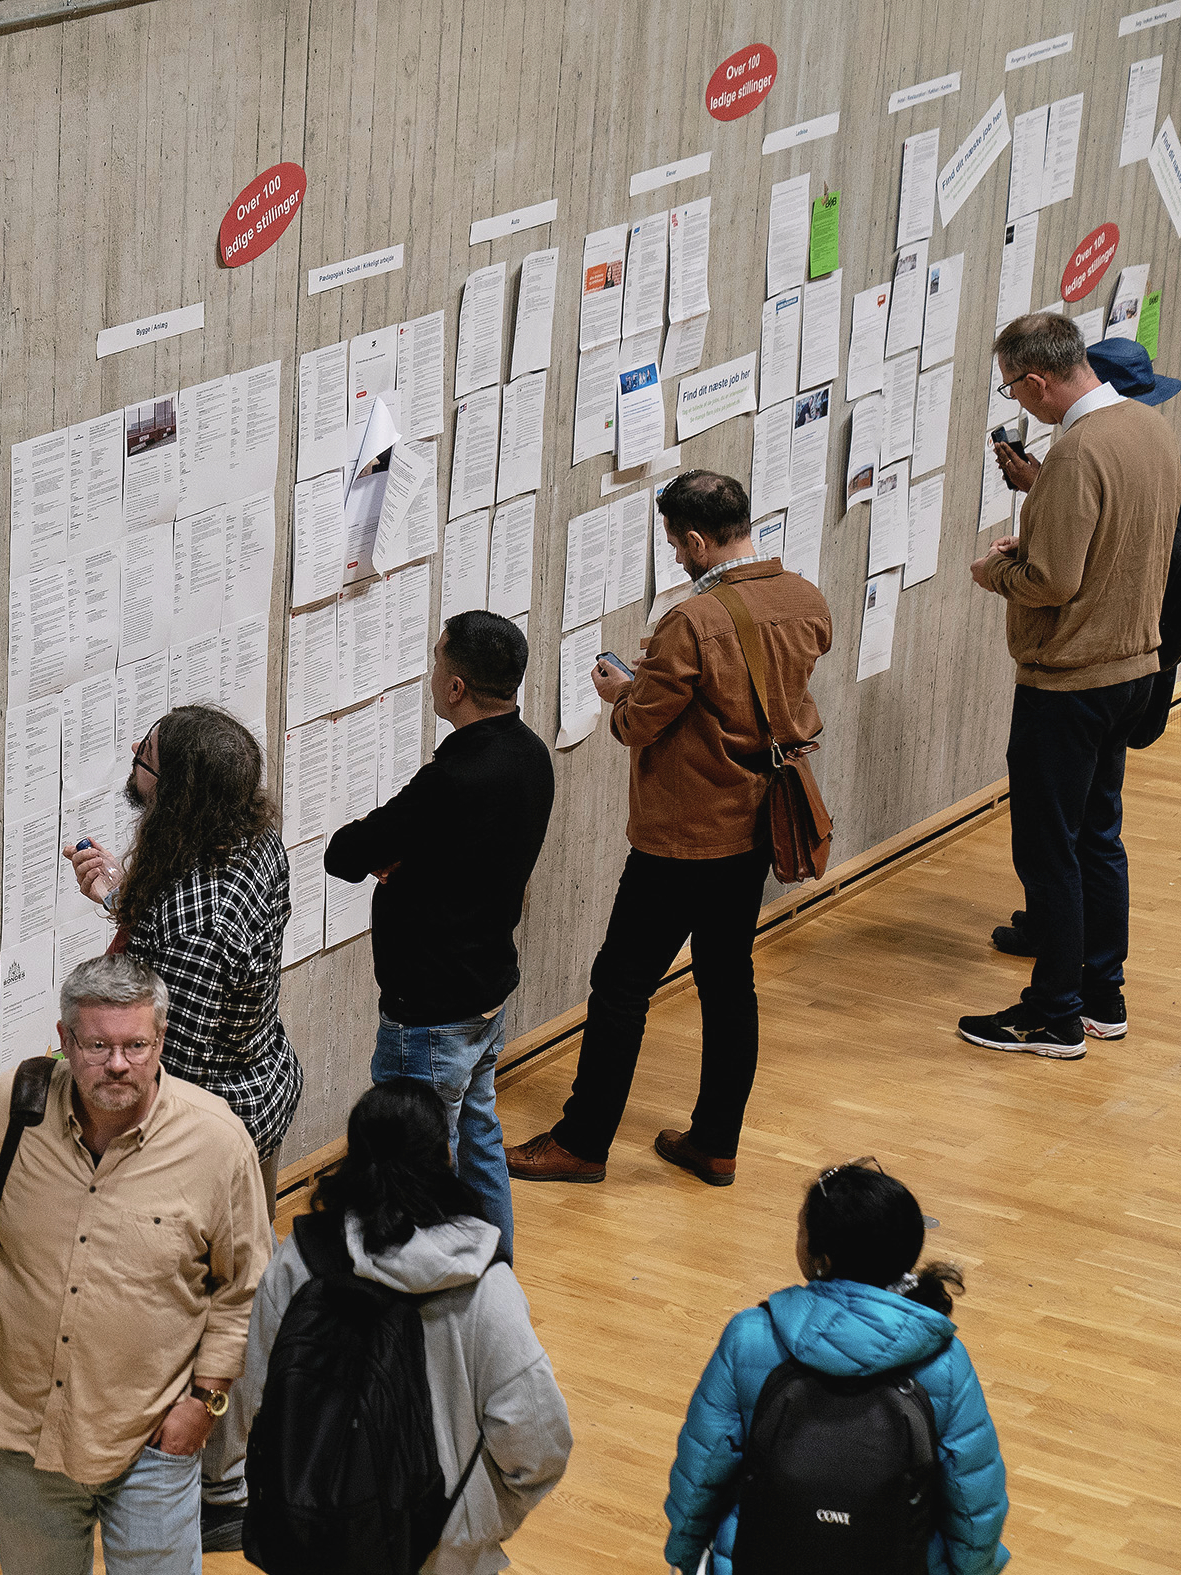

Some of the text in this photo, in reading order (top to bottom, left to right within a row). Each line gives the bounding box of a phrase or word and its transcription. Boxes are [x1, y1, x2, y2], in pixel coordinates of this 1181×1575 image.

[726, 52, 761, 80] Over 100
[710, 74, 772, 110] ledige stillinger
[942, 169, 955, 191] Find
[965, 136, 981, 161] næste
[983, 123, 992, 140] job
[993, 109, 1002, 124] her
[1162, 131, 1171, 151] Find
[237, 174, 281, 221] Over 100
[225, 189, 300, 260] ledige stillinger
[1076, 232, 1105, 267] Over 100
[319, 270, 344, 282] Pædagogisk
[347, 264, 361, 274] Socialt
[364, 260, 379, 270] Kirkeligt
[380, 255, 394, 265] arbejde
[1065, 243, 1116, 296] ledige stillinger
[136, 324, 150, 336] Bygge
[154, 321, 168, 332] Anlæg
[683, 369, 750, 402] Find dit næste job her
